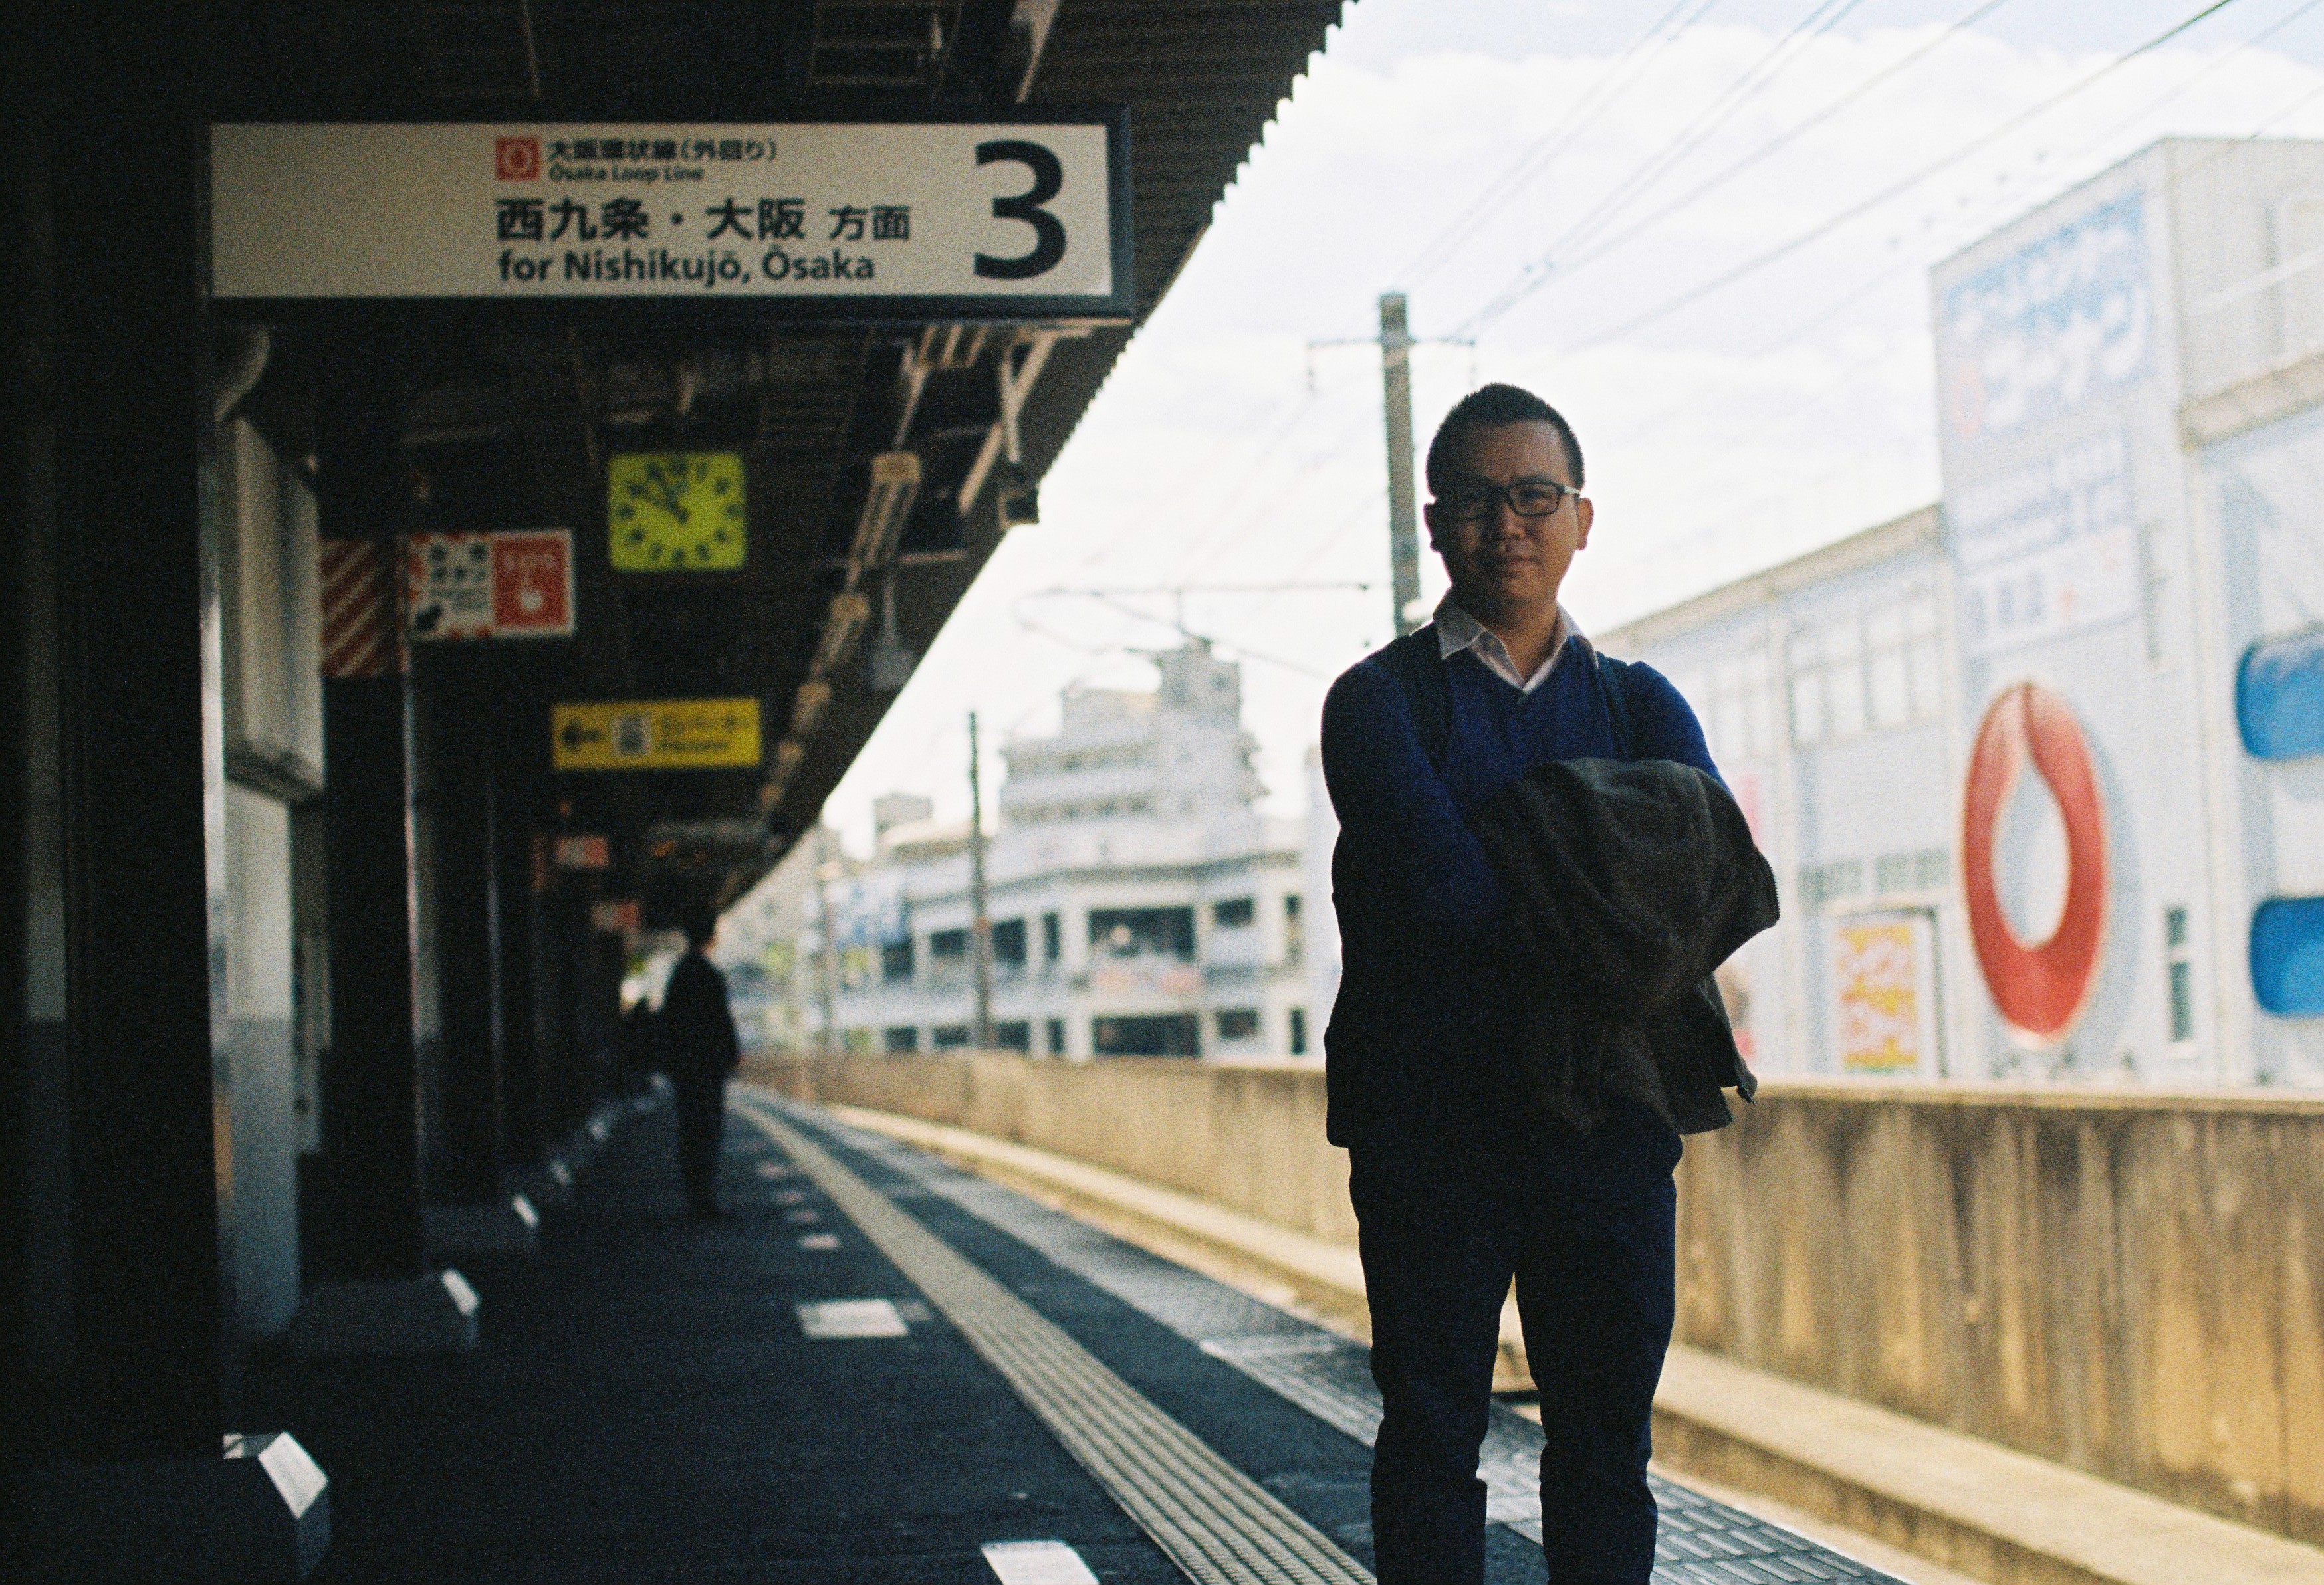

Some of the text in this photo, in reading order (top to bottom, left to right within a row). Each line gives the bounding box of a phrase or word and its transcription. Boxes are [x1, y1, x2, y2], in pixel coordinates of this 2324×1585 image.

[828, 205, 911, 241] 方面
[973, 139, 1067, 281] 3
[495, 251, 554, 282] for
